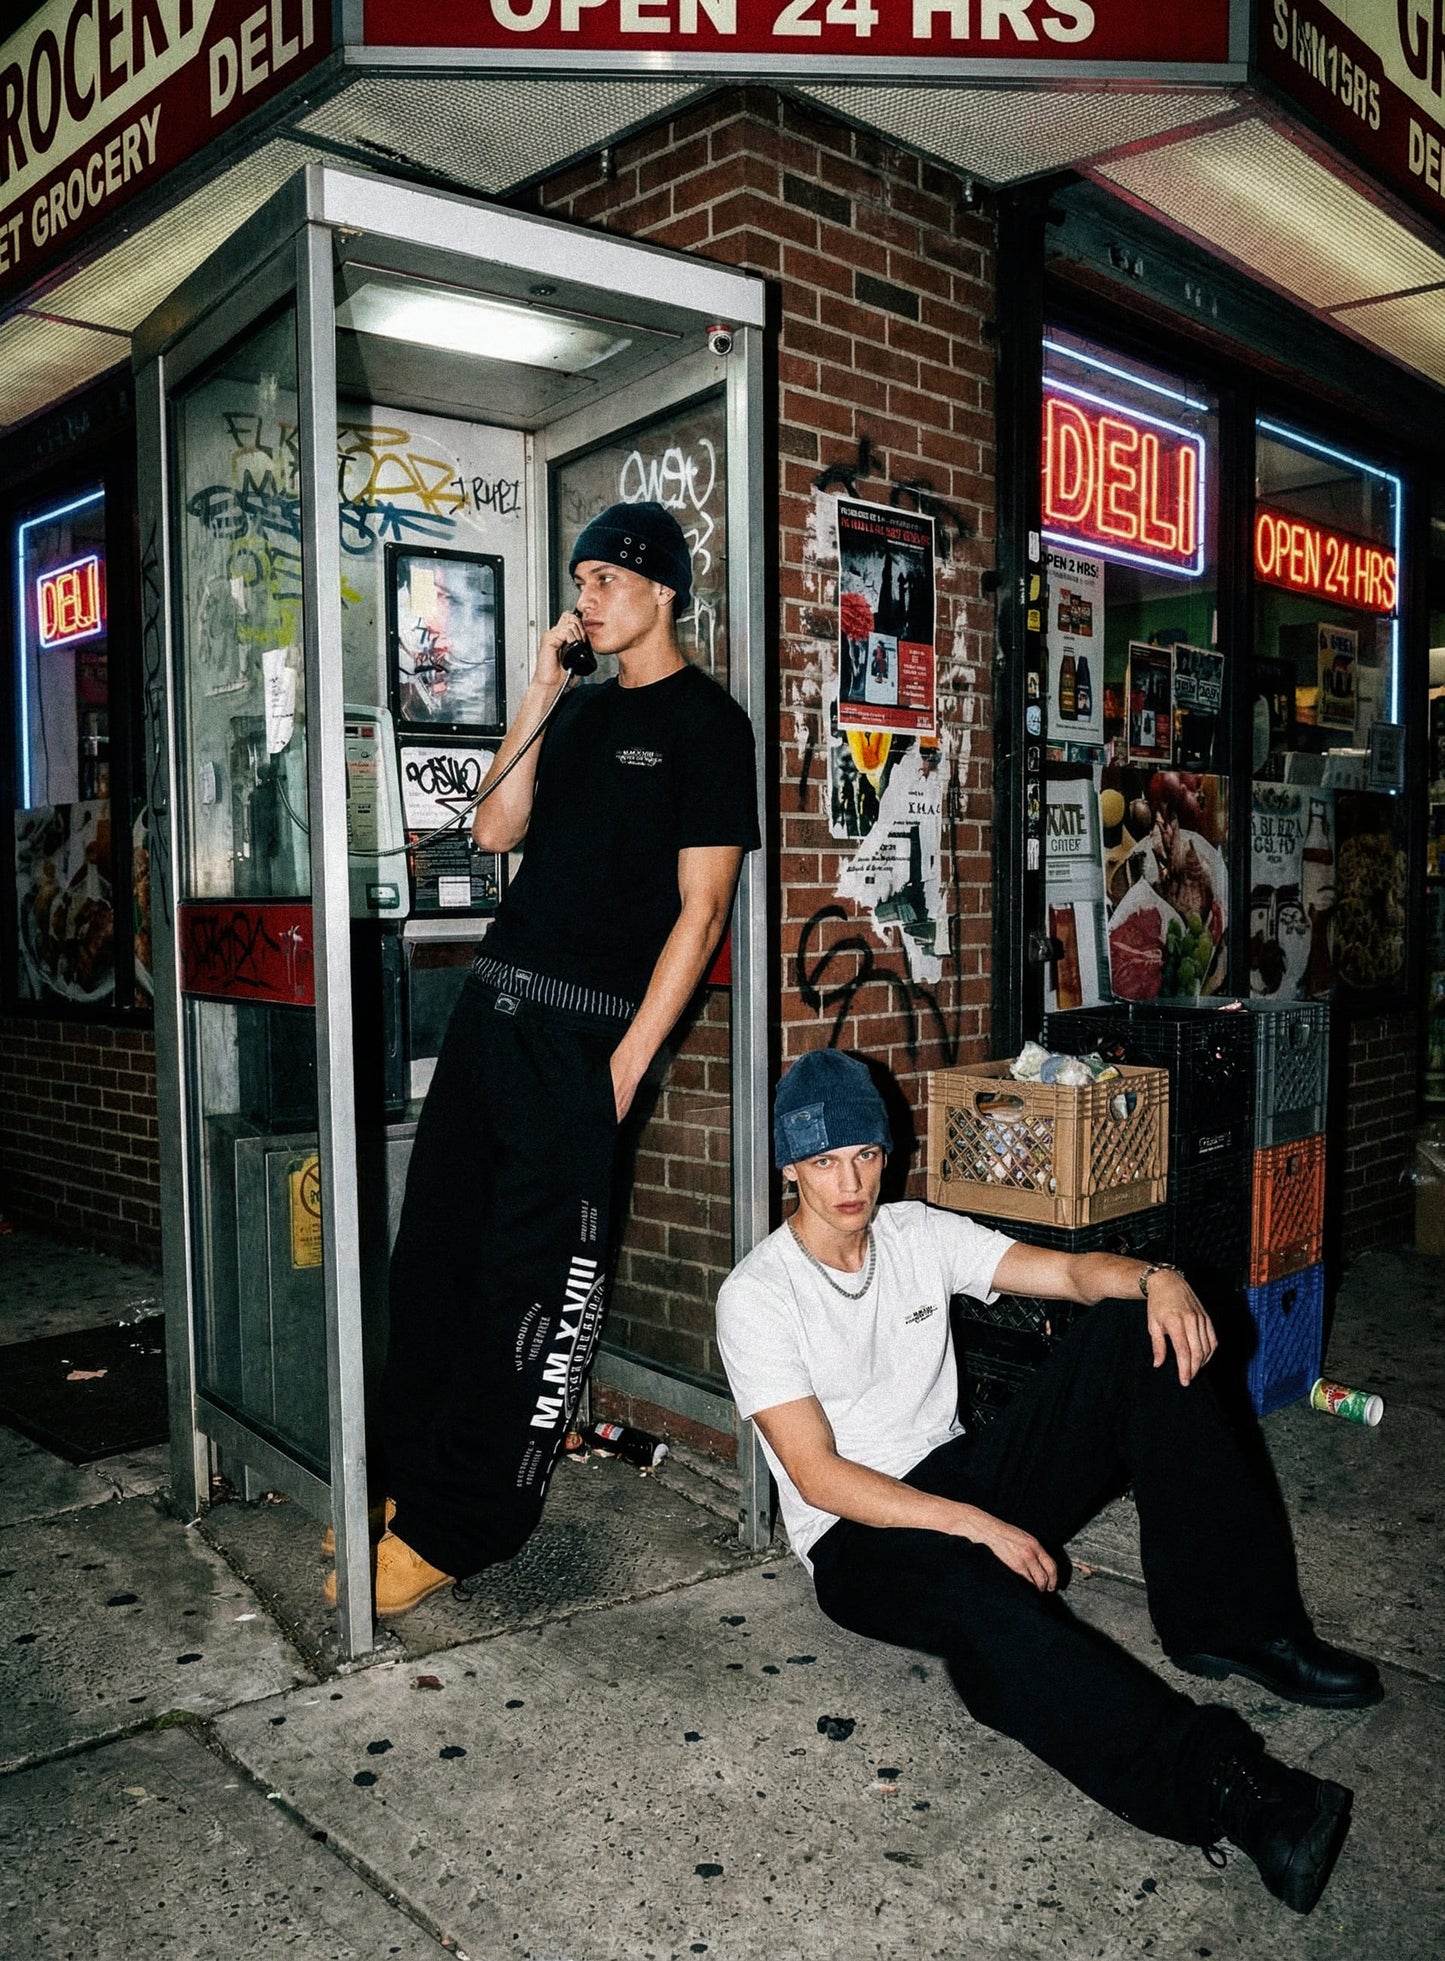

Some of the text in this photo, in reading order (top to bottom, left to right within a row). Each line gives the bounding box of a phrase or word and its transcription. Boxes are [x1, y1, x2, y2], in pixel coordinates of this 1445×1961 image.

[208, 0, 315, 119] DELI
[31, 102, 162, 248] GROCERY
[1044, 397, 1197, 556] DELI
[42, 562, 97, 640] DELI
[1256, 513, 1396, 609] OPEN 24 HRS
